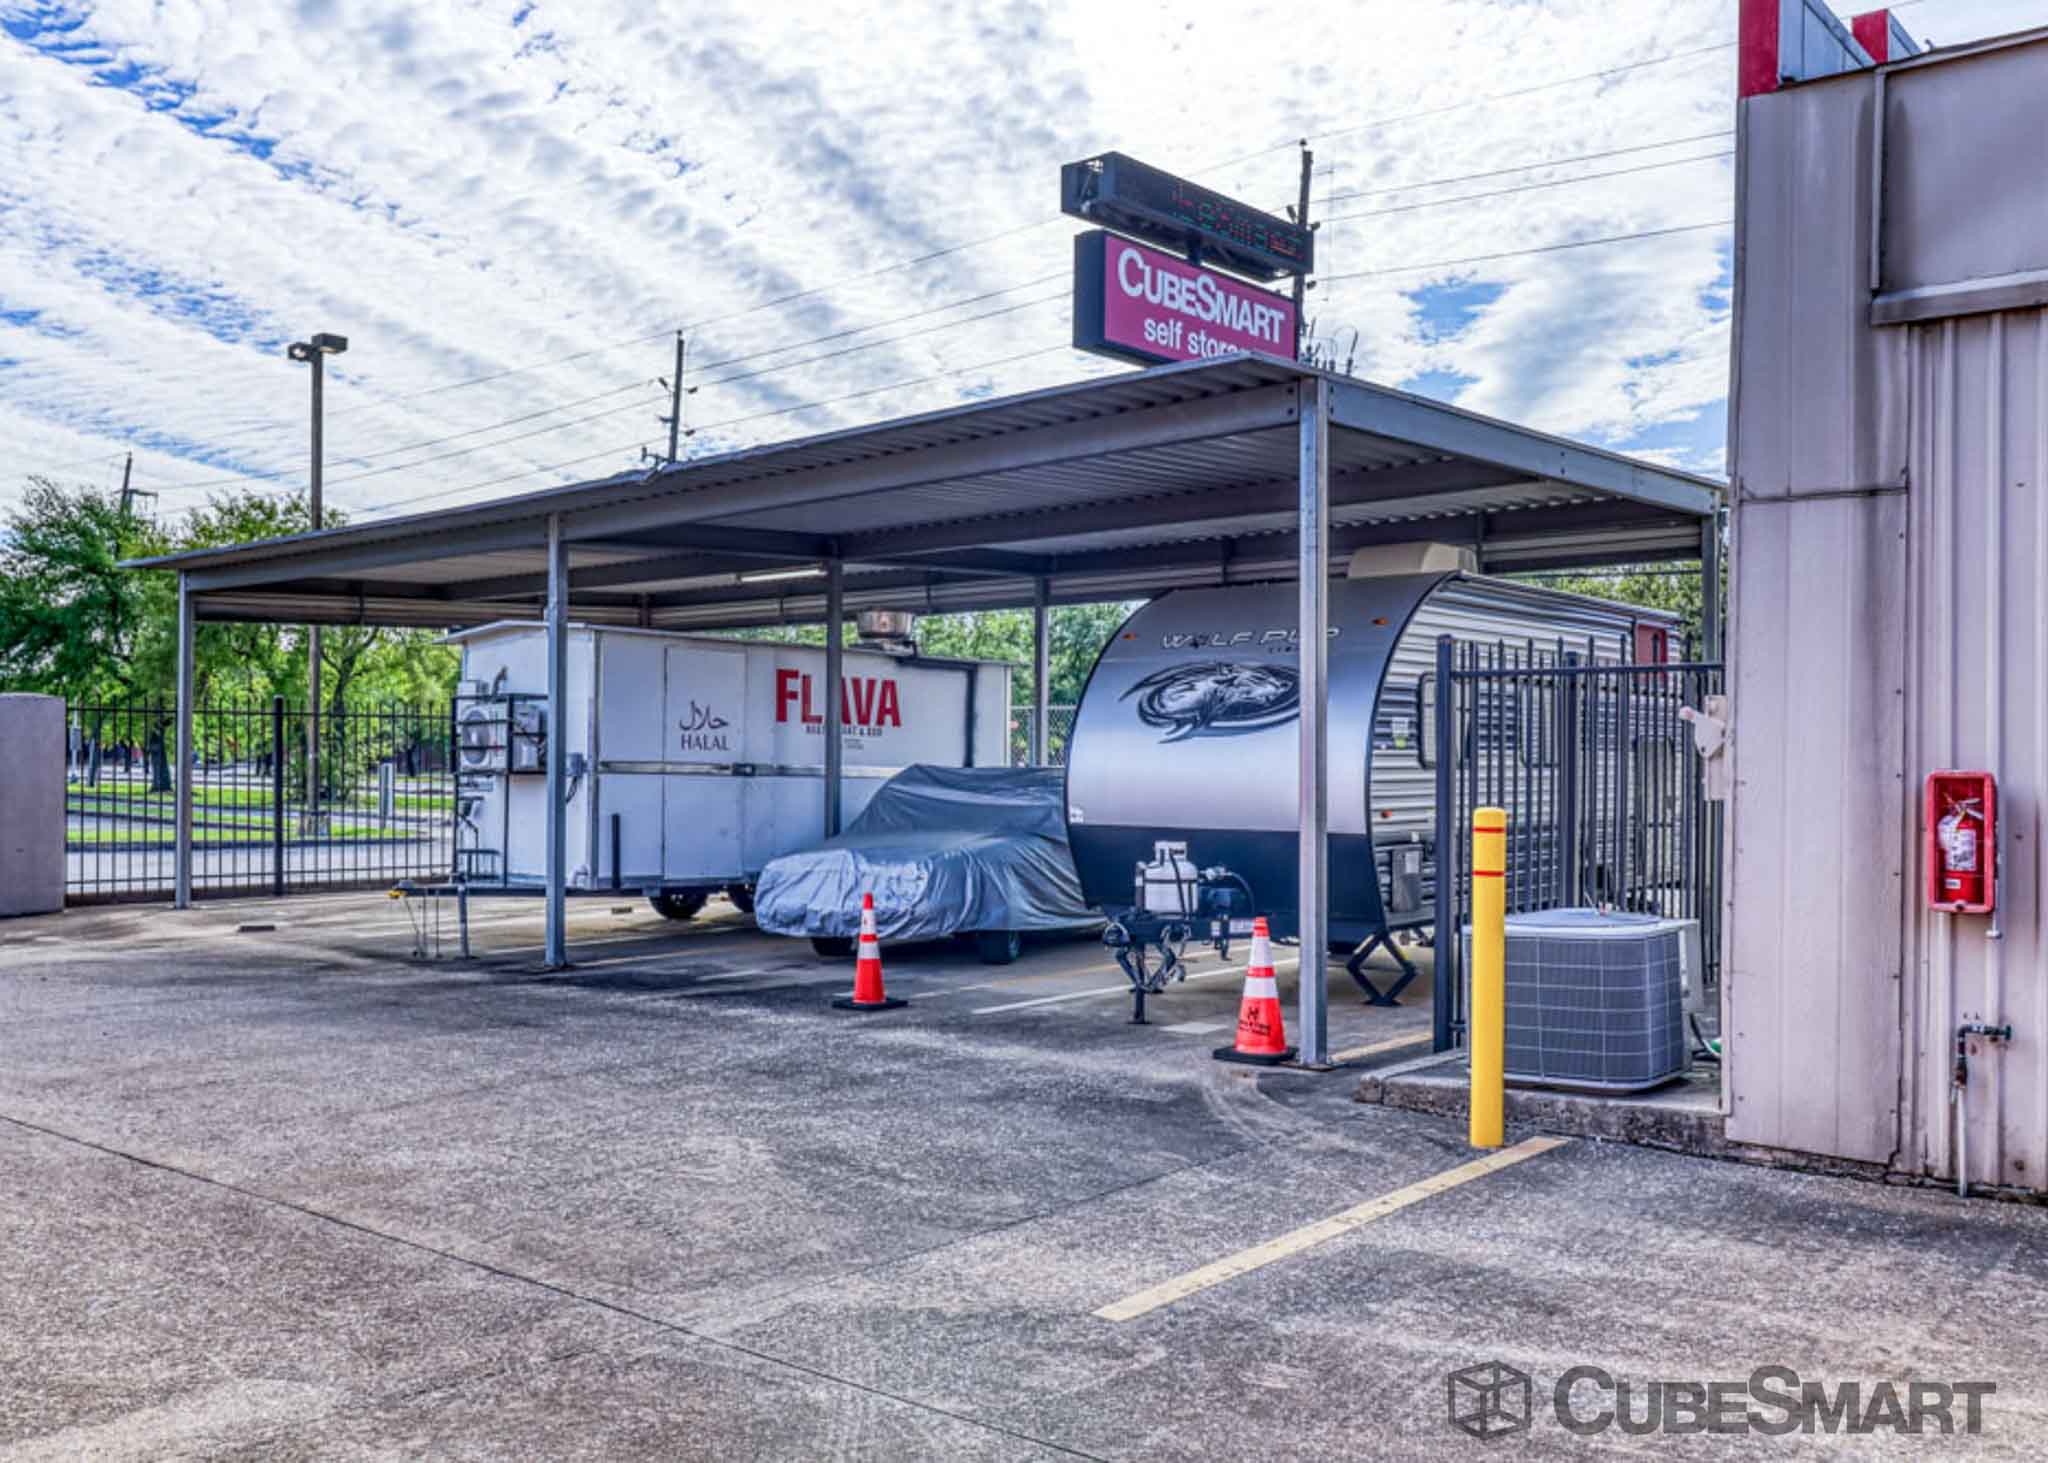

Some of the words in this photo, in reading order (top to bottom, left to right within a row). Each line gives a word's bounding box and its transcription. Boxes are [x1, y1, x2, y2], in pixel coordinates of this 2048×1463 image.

[1143, 317, 1183, 351] self
[1187, 330, 1240, 358] stor
[1161, 631, 1254, 649] WLF
[681, 733, 731, 751] HALAL
